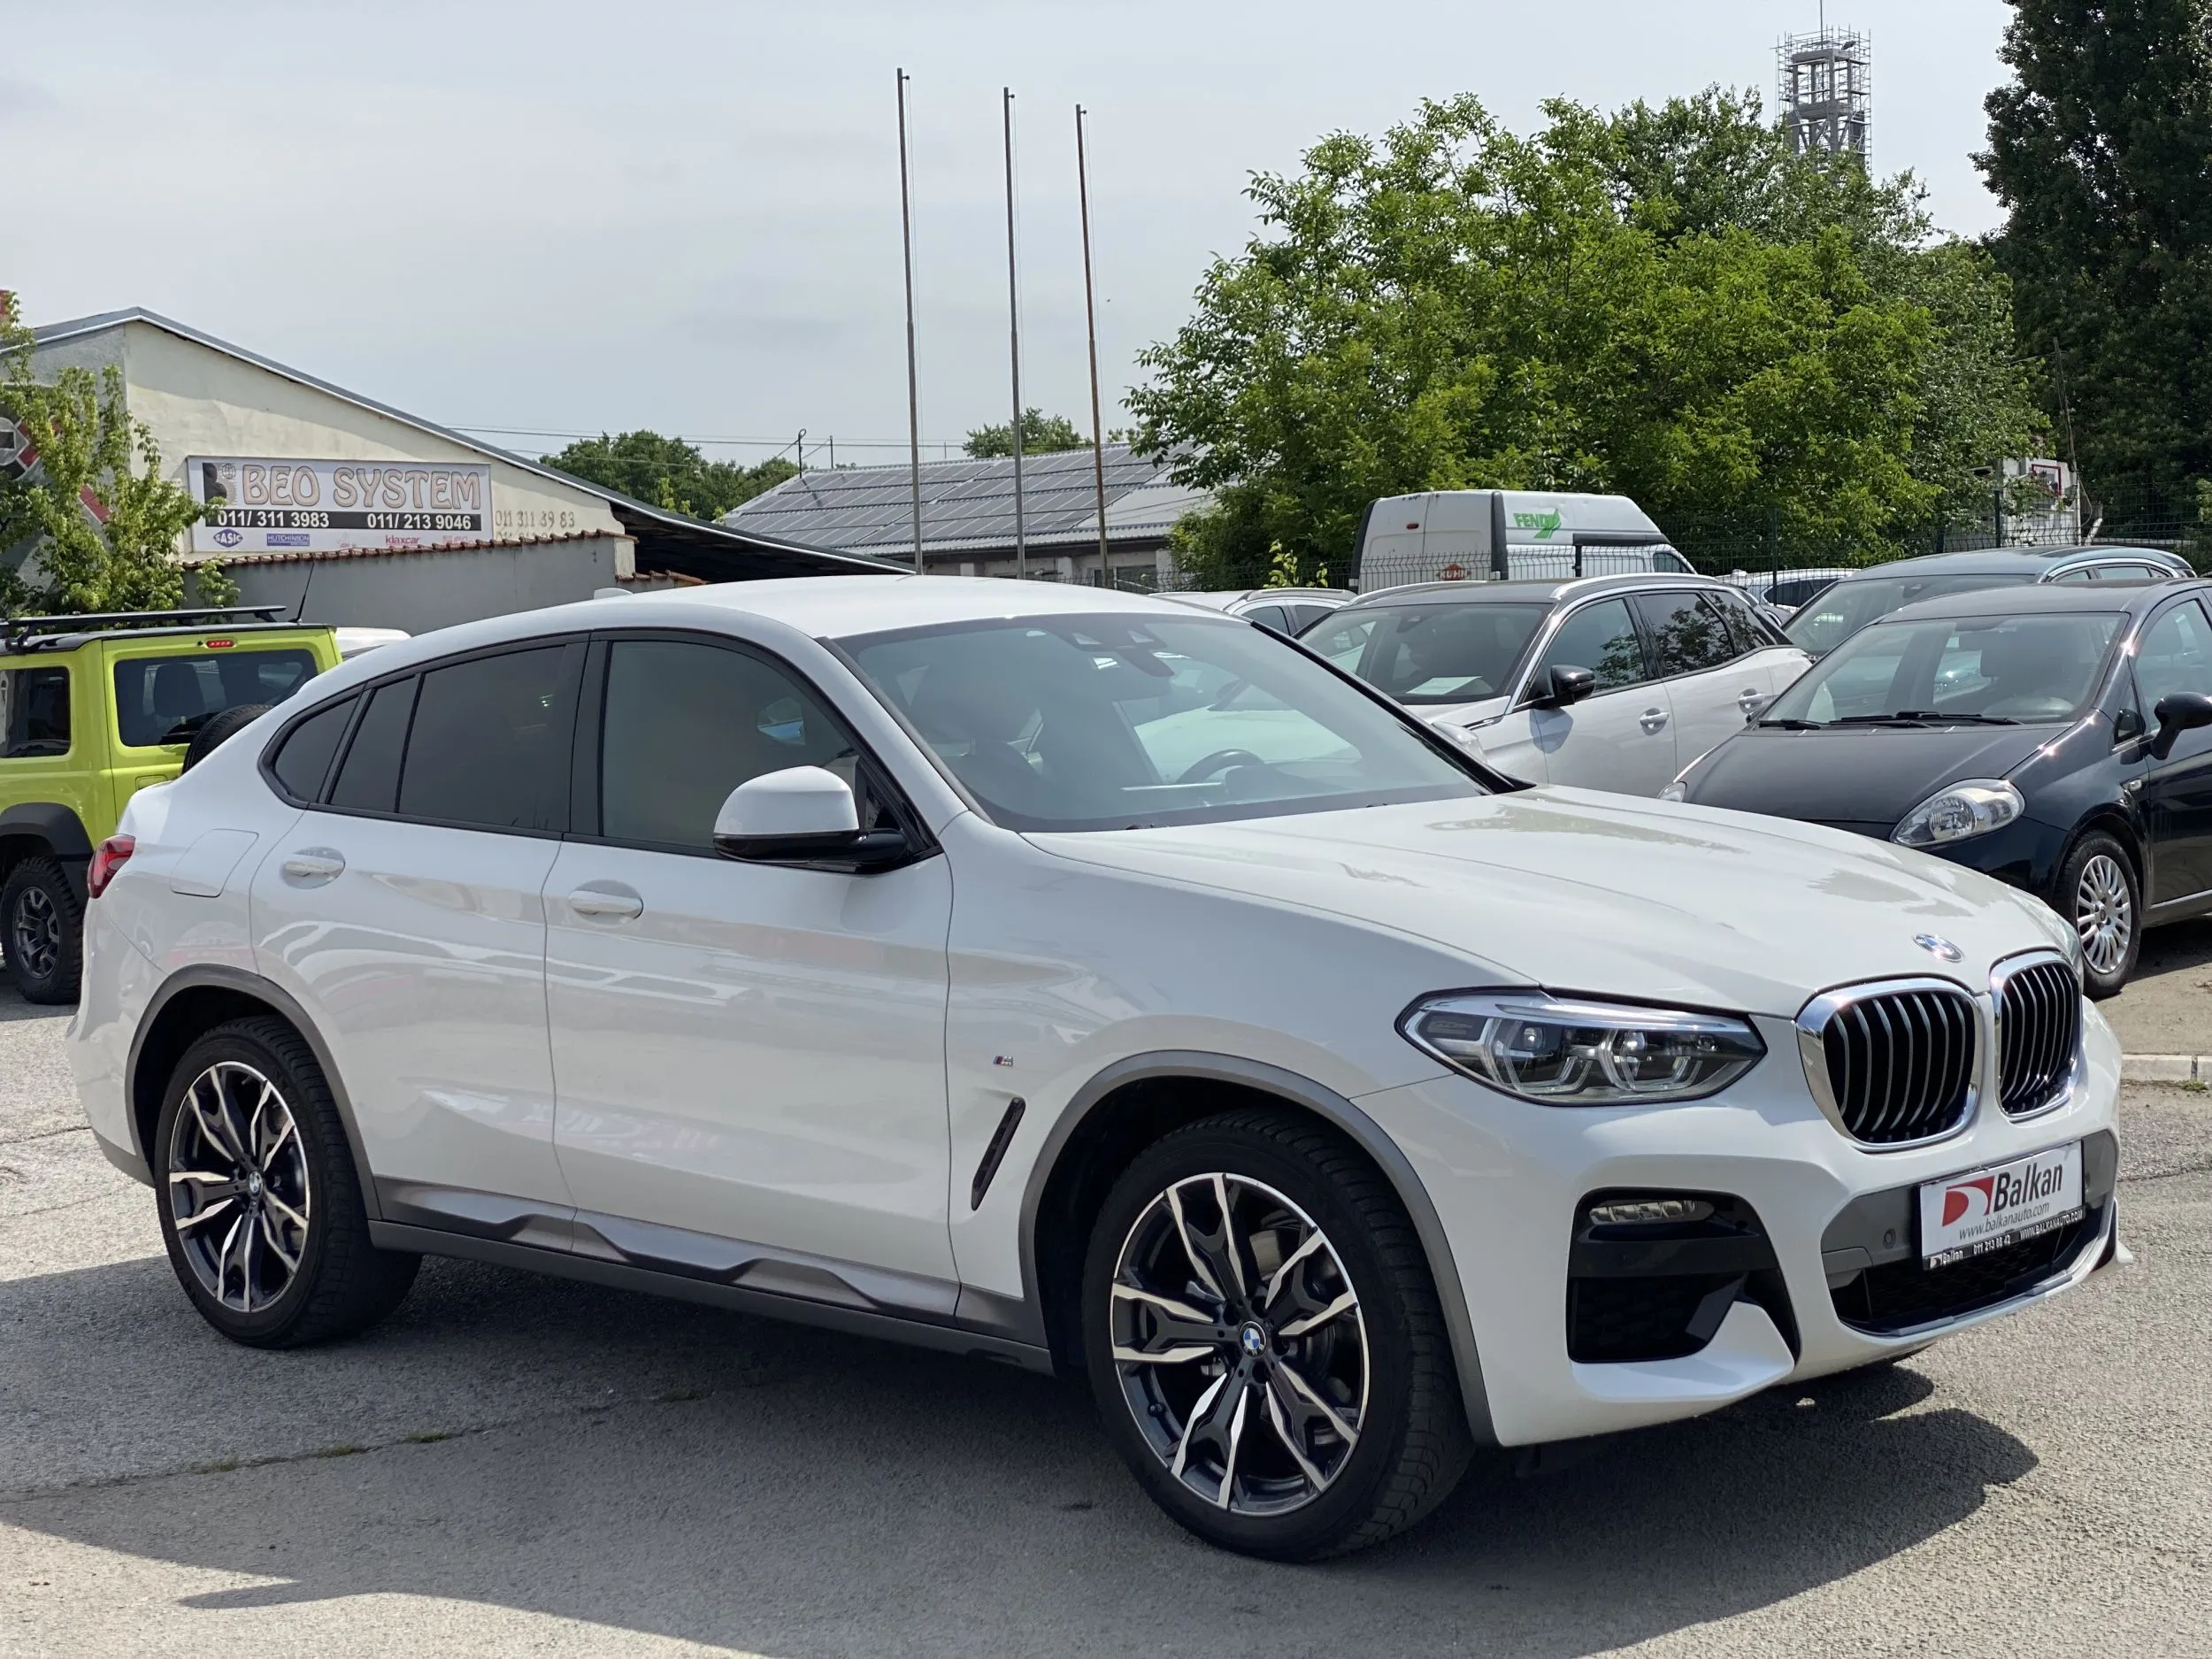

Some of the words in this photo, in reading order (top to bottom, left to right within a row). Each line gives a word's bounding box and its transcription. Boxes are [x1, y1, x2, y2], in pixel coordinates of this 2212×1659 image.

[242, 464, 320, 507] BEO
[334, 466, 481, 511] SYSTEM
[217, 511, 252, 526] 011/
[257, 511, 284, 527] 311
[291, 512, 330, 528] 3983
[367, 513, 400, 529] 011/
[404, 514, 432, 529] 213
[436, 515, 472, 530] 9046
[495, 510, 512, 527] 011
[517, 510, 535, 528] 311
[560, 511, 575, 528] 83
[213, 531, 243, 544] SASIC
[386, 534, 421, 545] klaxcar
[1440, 570, 1468, 579] KUHN
[1993, 1162, 2063, 1212] Balkan
[1958, 1201, 2050, 1240] www.balkanauto.com
